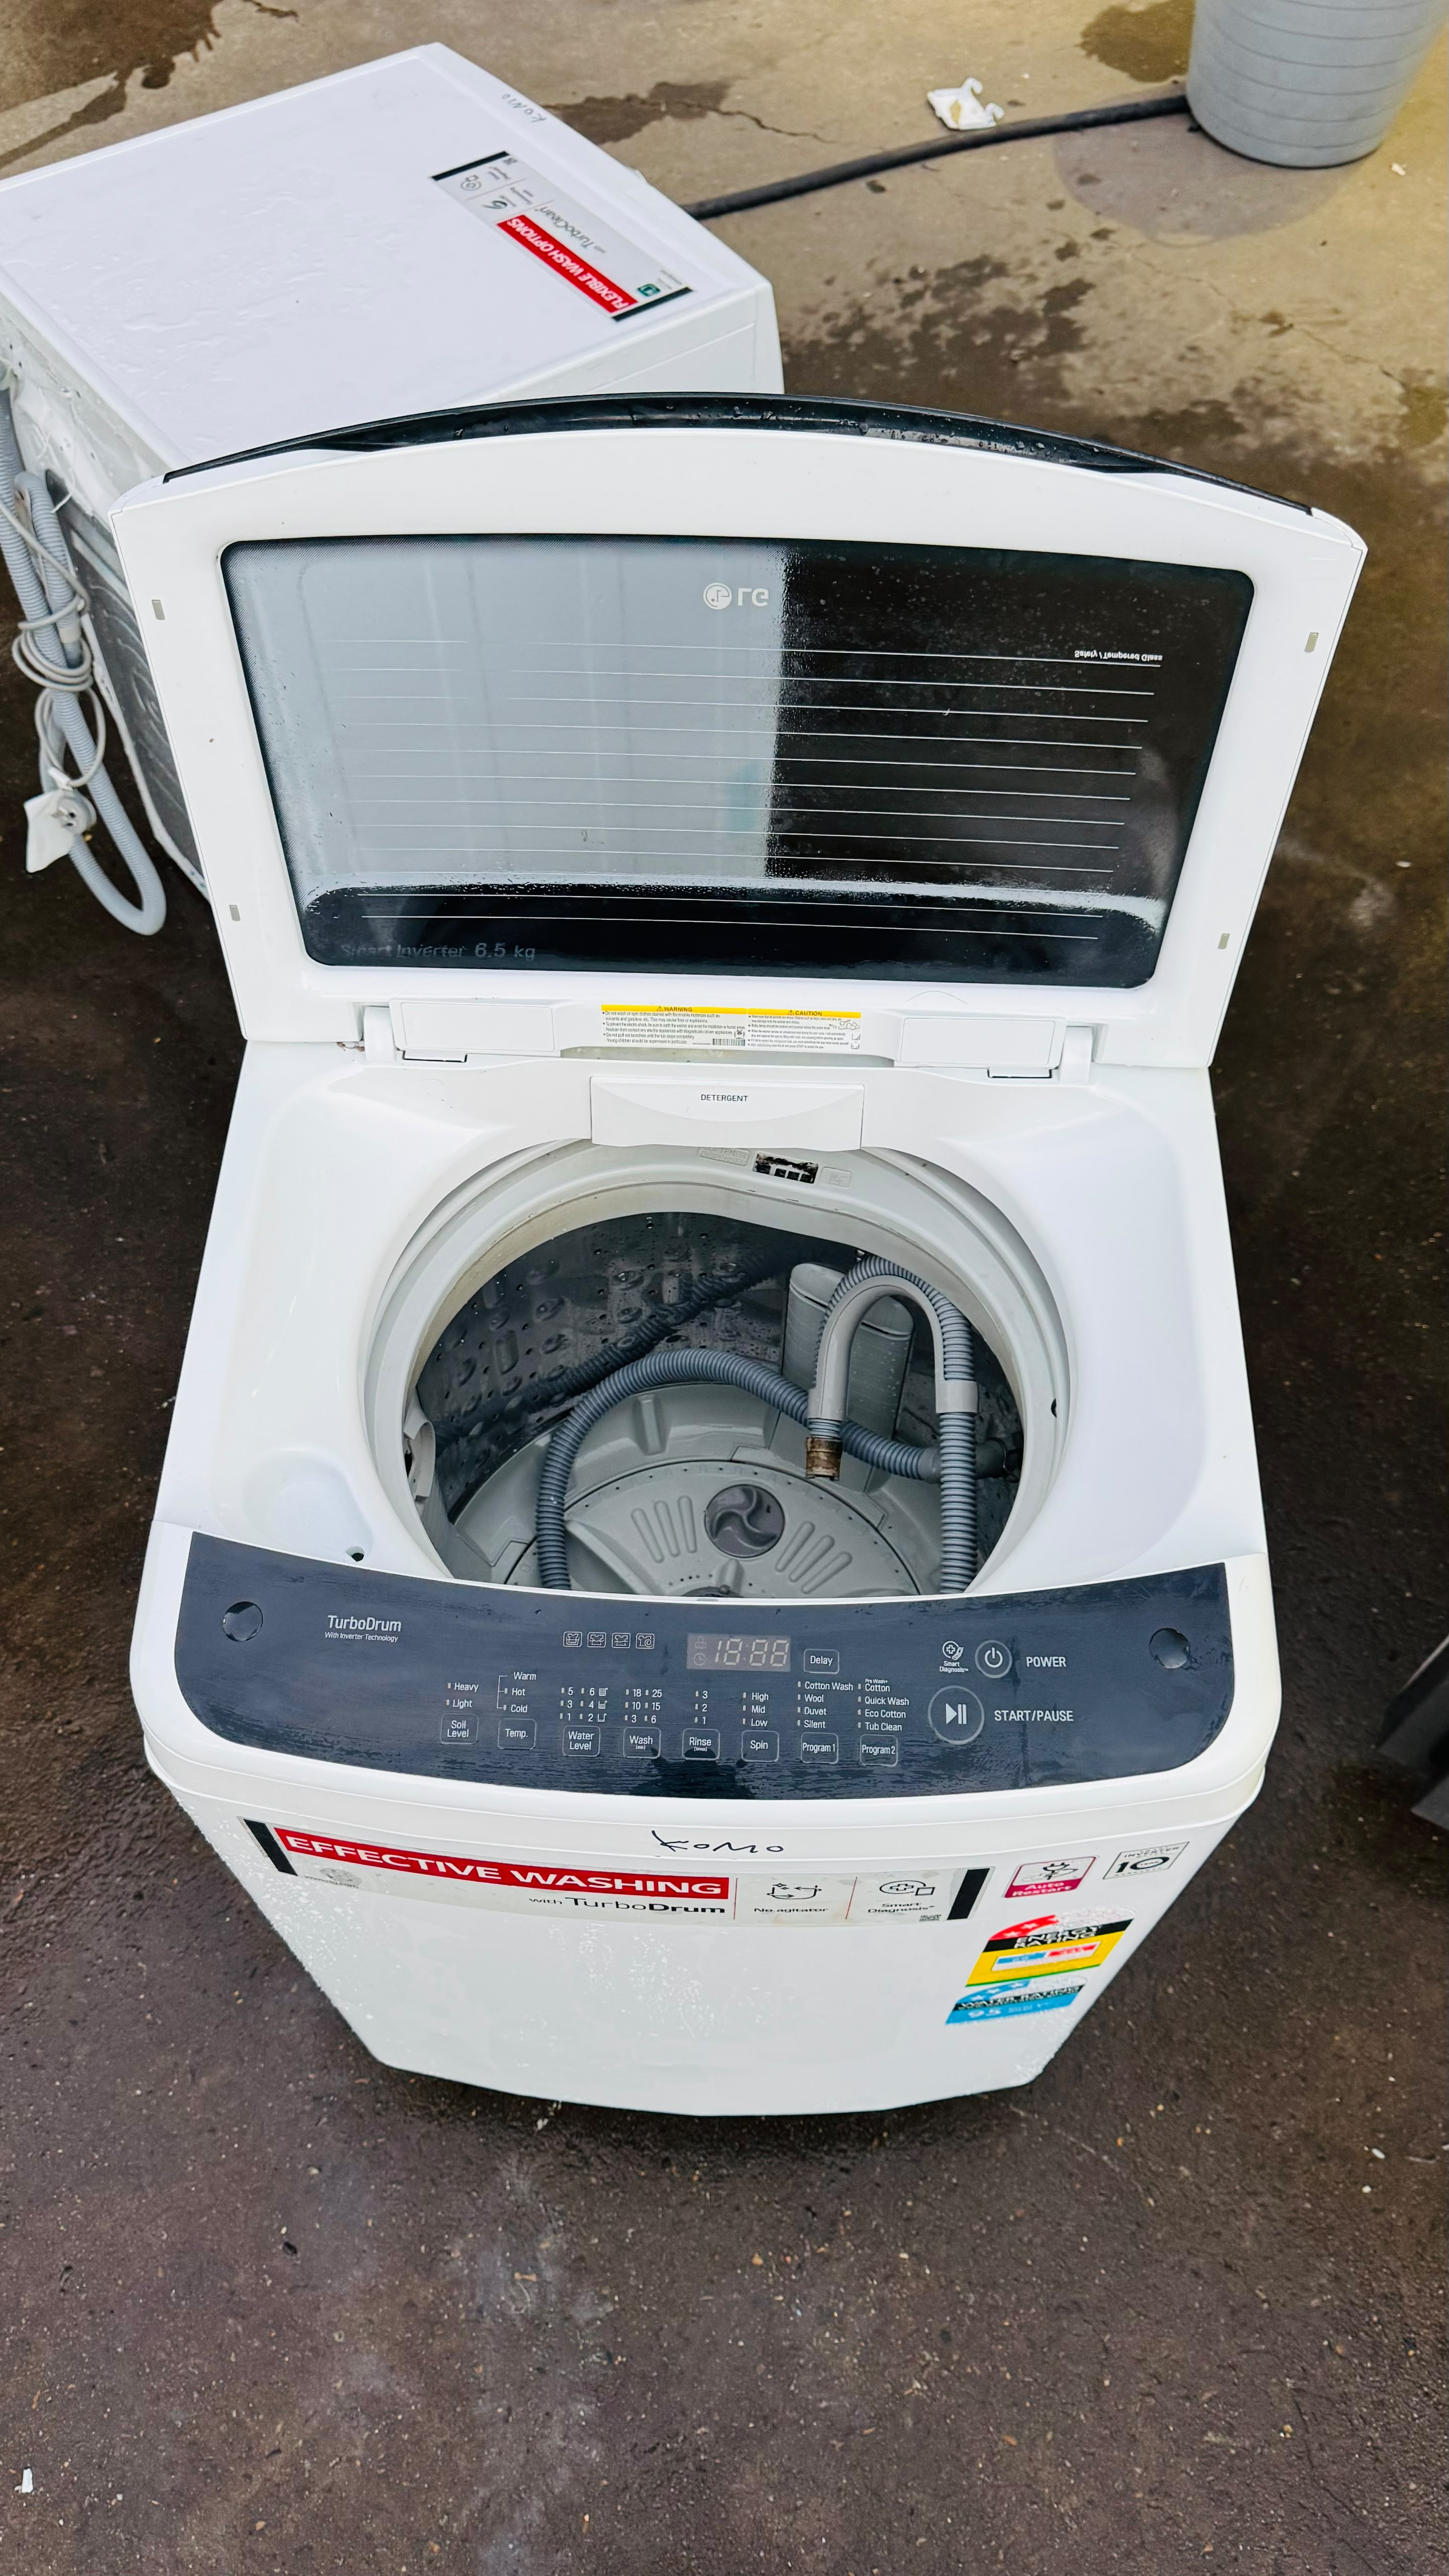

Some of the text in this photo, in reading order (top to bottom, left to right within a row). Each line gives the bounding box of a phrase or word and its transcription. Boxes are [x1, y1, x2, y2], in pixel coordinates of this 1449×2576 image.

[507, 218, 554, 253] OPTIONS
[547, 250, 584, 276] WASH
[577, 272, 629, 309] FLEXIBLE
[397, 943, 464, 958] Inverter
[474, 942, 506, 958] 6.5
[514, 945, 536, 961] kg
[700, 1151, 745, 1164] DISPENSER
[328, 1615, 401, 1632] TurboDrum
[340, 1632, 363, 1640] Inverter
[365, 1634, 398, 1643] Technology
[810, 1655, 833, 1666] Delay
[1026, 1656, 1067, 1667] POWER
[514, 1671, 536, 1680] Warm
[454, 1682, 478, 1693] Heavy
[804, 1681, 854, 1691] Cotton Wash
[865, 1683, 891, 1692] Cotton
[512, 1687, 525, 1696] Hot
[568, 1687, 595, 1696] 5 6
[632, 1688, 662, 1698] 18 25
[702, 1691, 708, 1699] 3
[752, 1692, 769, 1702] High
[804, 1694, 824, 1703] Wool
[864, 1696, 909, 1706] Quick Wash
[453, 1700, 472, 1709] Light
[511, 1705, 528, 1713] Cold
[567, 1700, 594, 1709] 3 4
[632, 1702, 661, 1711] 10 15
[702, 1704, 707, 1712] 2
[751, 1705, 766, 1714] Mid
[804, 1707, 827, 1716] Duvet
[864, 1709, 906, 1719] Eco Cotton
[567, 1713, 593, 1722] 1 2
[631, 1715, 657, 1723] 3 6
[702, 1716, 706, 1725] 1
[994, 1710, 1074, 1722] START/PAUSE
[451, 1720, 466, 1729] Soil
[751, 1718, 768, 1727] Low
[804, 1720, 826, 1729] Silent
[865, 1722, 902, 1731] Tub Clean
[447, 1729, 469, 1738] Level
[505, 1729, 528, 1738] Temp.
[568, 1731, 594, 1740] Water
[629, 1735, 653, 1744] Wash
[689, 1737, 711, 1746] Rinse
[570, 1741, 592, 1750] Level
[750, 1740, 768, 1750] Spin
[802, 1743, 836, 1753] Program 1
[862, 1744, 895, 1755] Program 2
[285, 1835, 721, 1894] EFFECTIVE WASHING
[1024, 1882, 1065, 1890] Auto
[1012, 1885, 1072, 1897] Restart
[565, 1897, 725, 1913] TurboDrum
